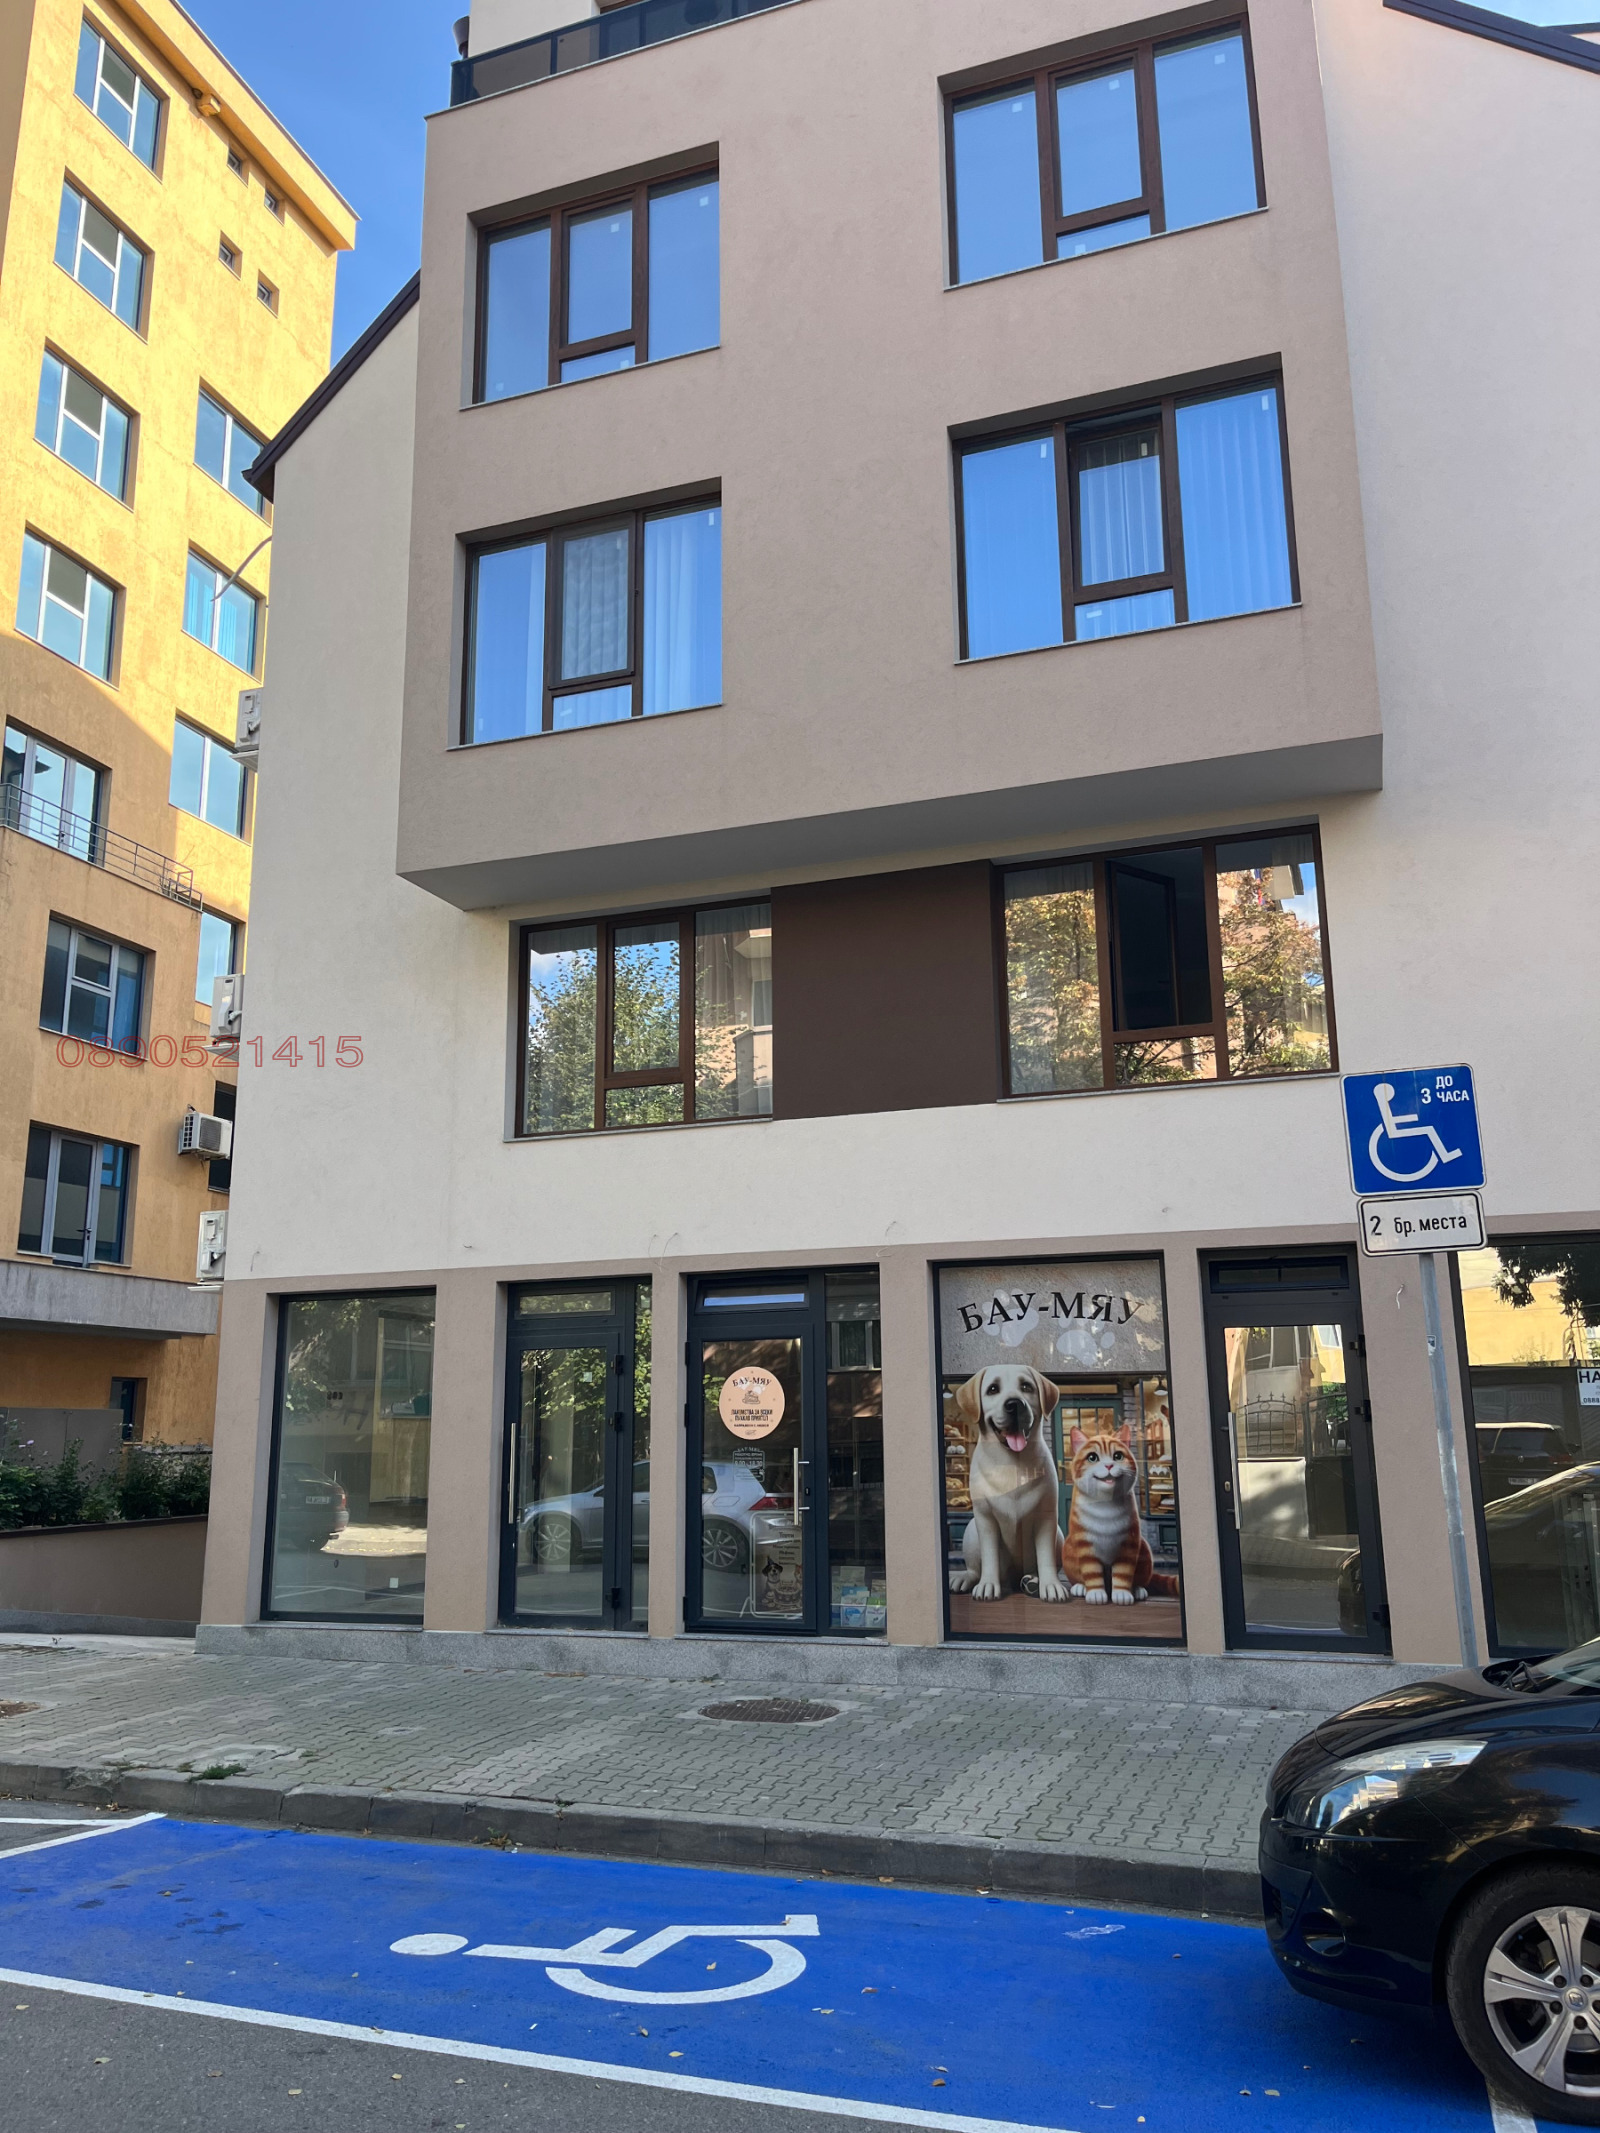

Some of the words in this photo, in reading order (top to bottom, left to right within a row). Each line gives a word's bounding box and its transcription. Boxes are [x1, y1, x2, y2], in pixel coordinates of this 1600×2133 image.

[1435, 1075, 1453, 1089] ДО
[1420, 1087, 1432, 1104] 3
[1436, 1090, 1470, 1103] ЧАСА
[1369, 1215, 1382, 1236] 2
[957, 1291, 1145, 1333] БАУ-МЯУ
[732, 1376, 772, 1387] БАУ-МЯУ
